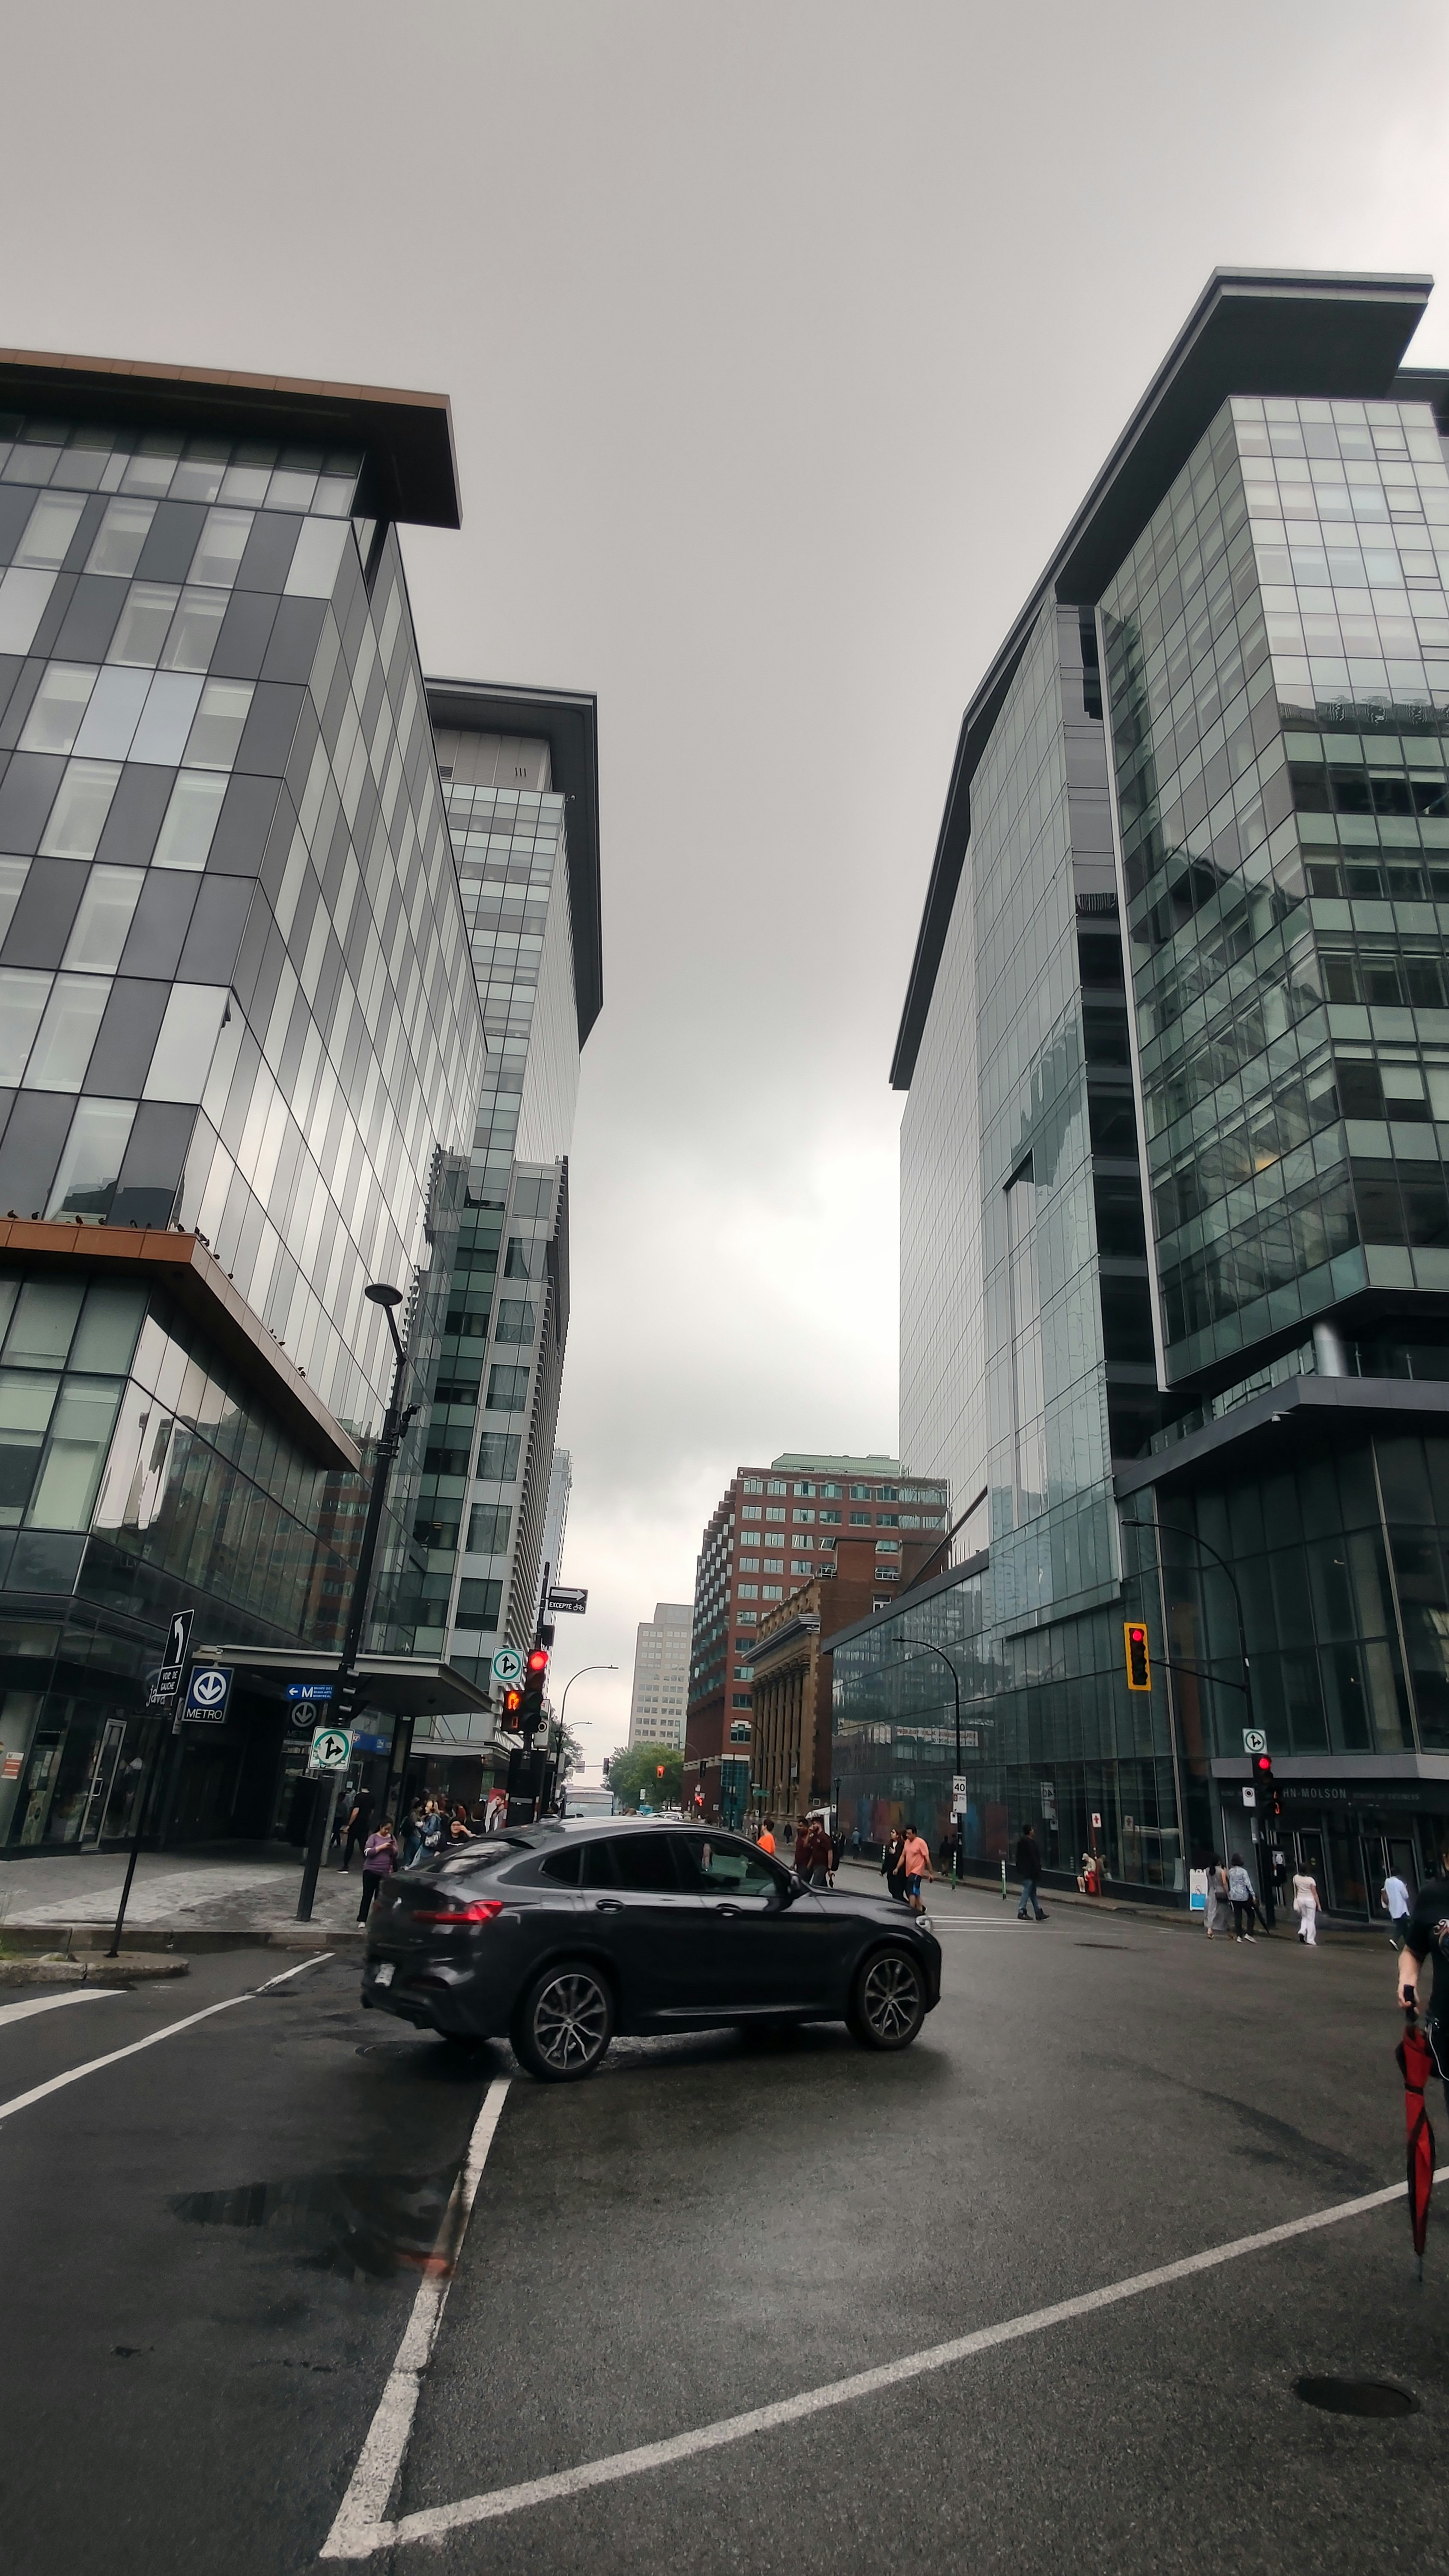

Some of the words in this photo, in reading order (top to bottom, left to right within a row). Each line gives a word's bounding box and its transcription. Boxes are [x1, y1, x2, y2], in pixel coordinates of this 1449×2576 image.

[163, 1672, 172, 1680] VOIE
[172, 1671, 178, 1679] DE
[160, 1681, 176, 1691] GAUCHE
[301, 1686, 313, 1697] M
[186, 1708, 223, 1720] METRO
[954, 1783, 965, 1792] 40
